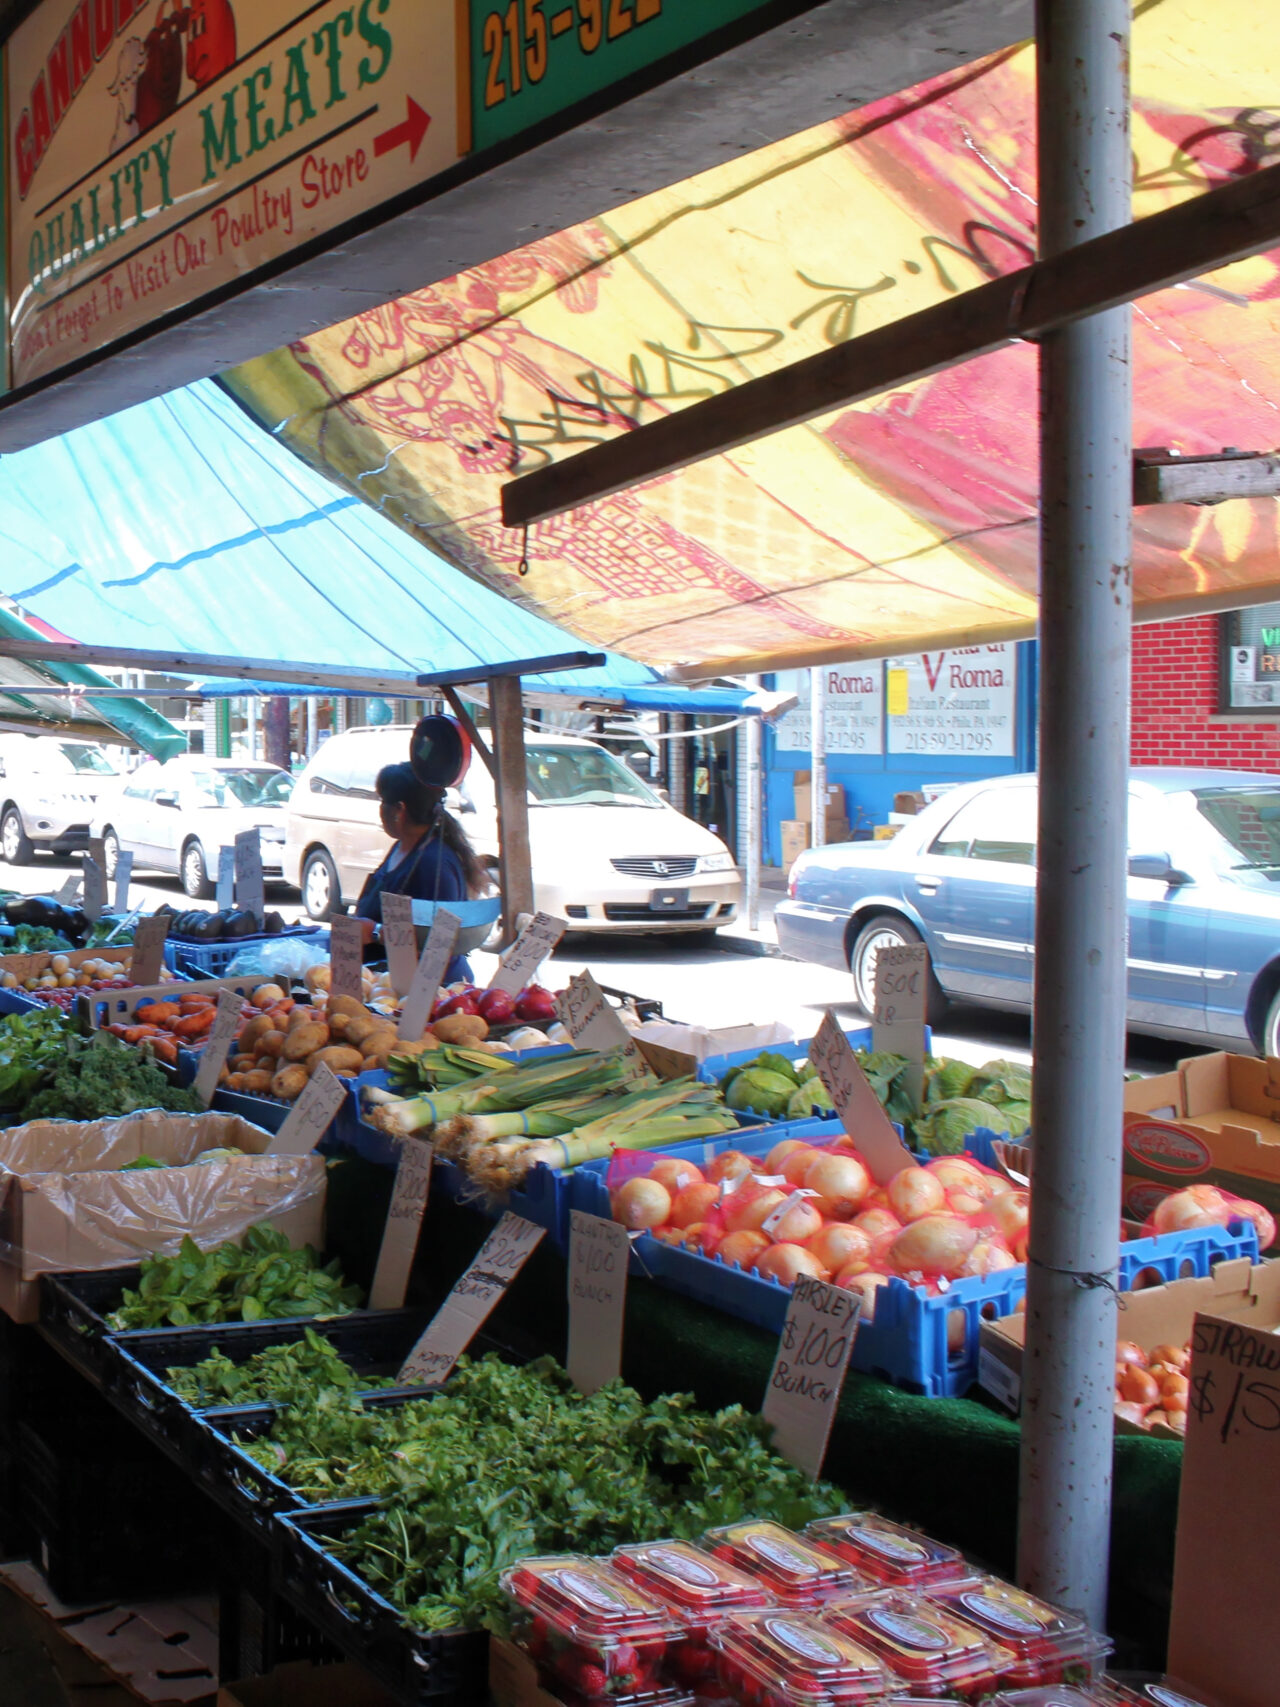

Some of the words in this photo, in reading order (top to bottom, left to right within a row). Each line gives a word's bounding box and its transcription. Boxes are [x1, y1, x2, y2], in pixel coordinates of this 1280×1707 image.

[483, 0, 662, 111] 215-9
[28, 133, 176, 295] QUALITY
[199, 0, 392, 184] MEATS
[53, 290, 100, 343] Forget
[100, 272, 124, 314] To
[127, 250, 170, 301] Visit
[173, 232, 207, 277] Our
[211, 185, 294, 256] Poultry
[300, 148, 370, 209] Store
[828, 671, 874, 694] Roma
[949, 664, 1004, 689] Roma
[793, 1273, 860, 1329] PARSLEY
